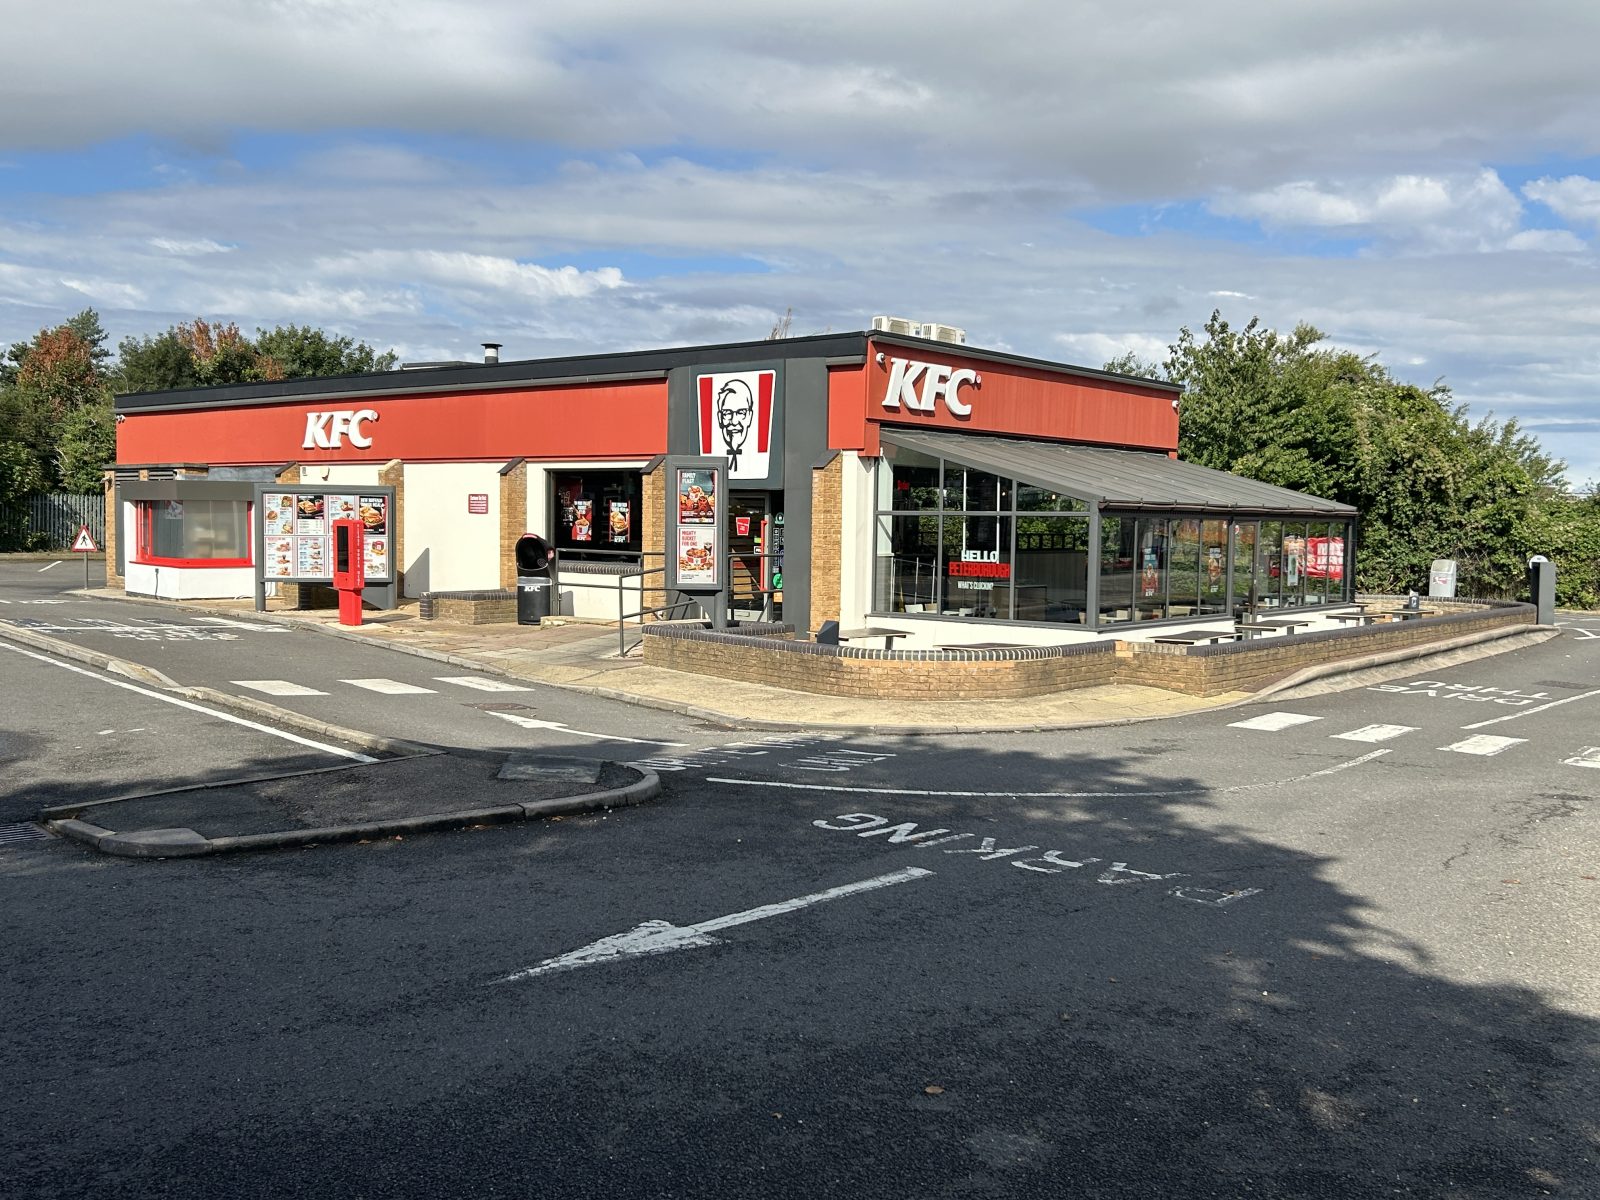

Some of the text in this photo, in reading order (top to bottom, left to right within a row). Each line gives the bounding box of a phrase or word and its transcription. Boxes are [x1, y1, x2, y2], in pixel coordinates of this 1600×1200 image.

[882, 358, 976, 416] KFC
[302, 410, 373, 449] KFC
[949, 562, 1010, 578] PETERBOROUGH
[1366, 684, 1533, 705] DRIVE
[1409, 680, 1553, 700] THRU
[810, 812, 1265, 906] PARKING
